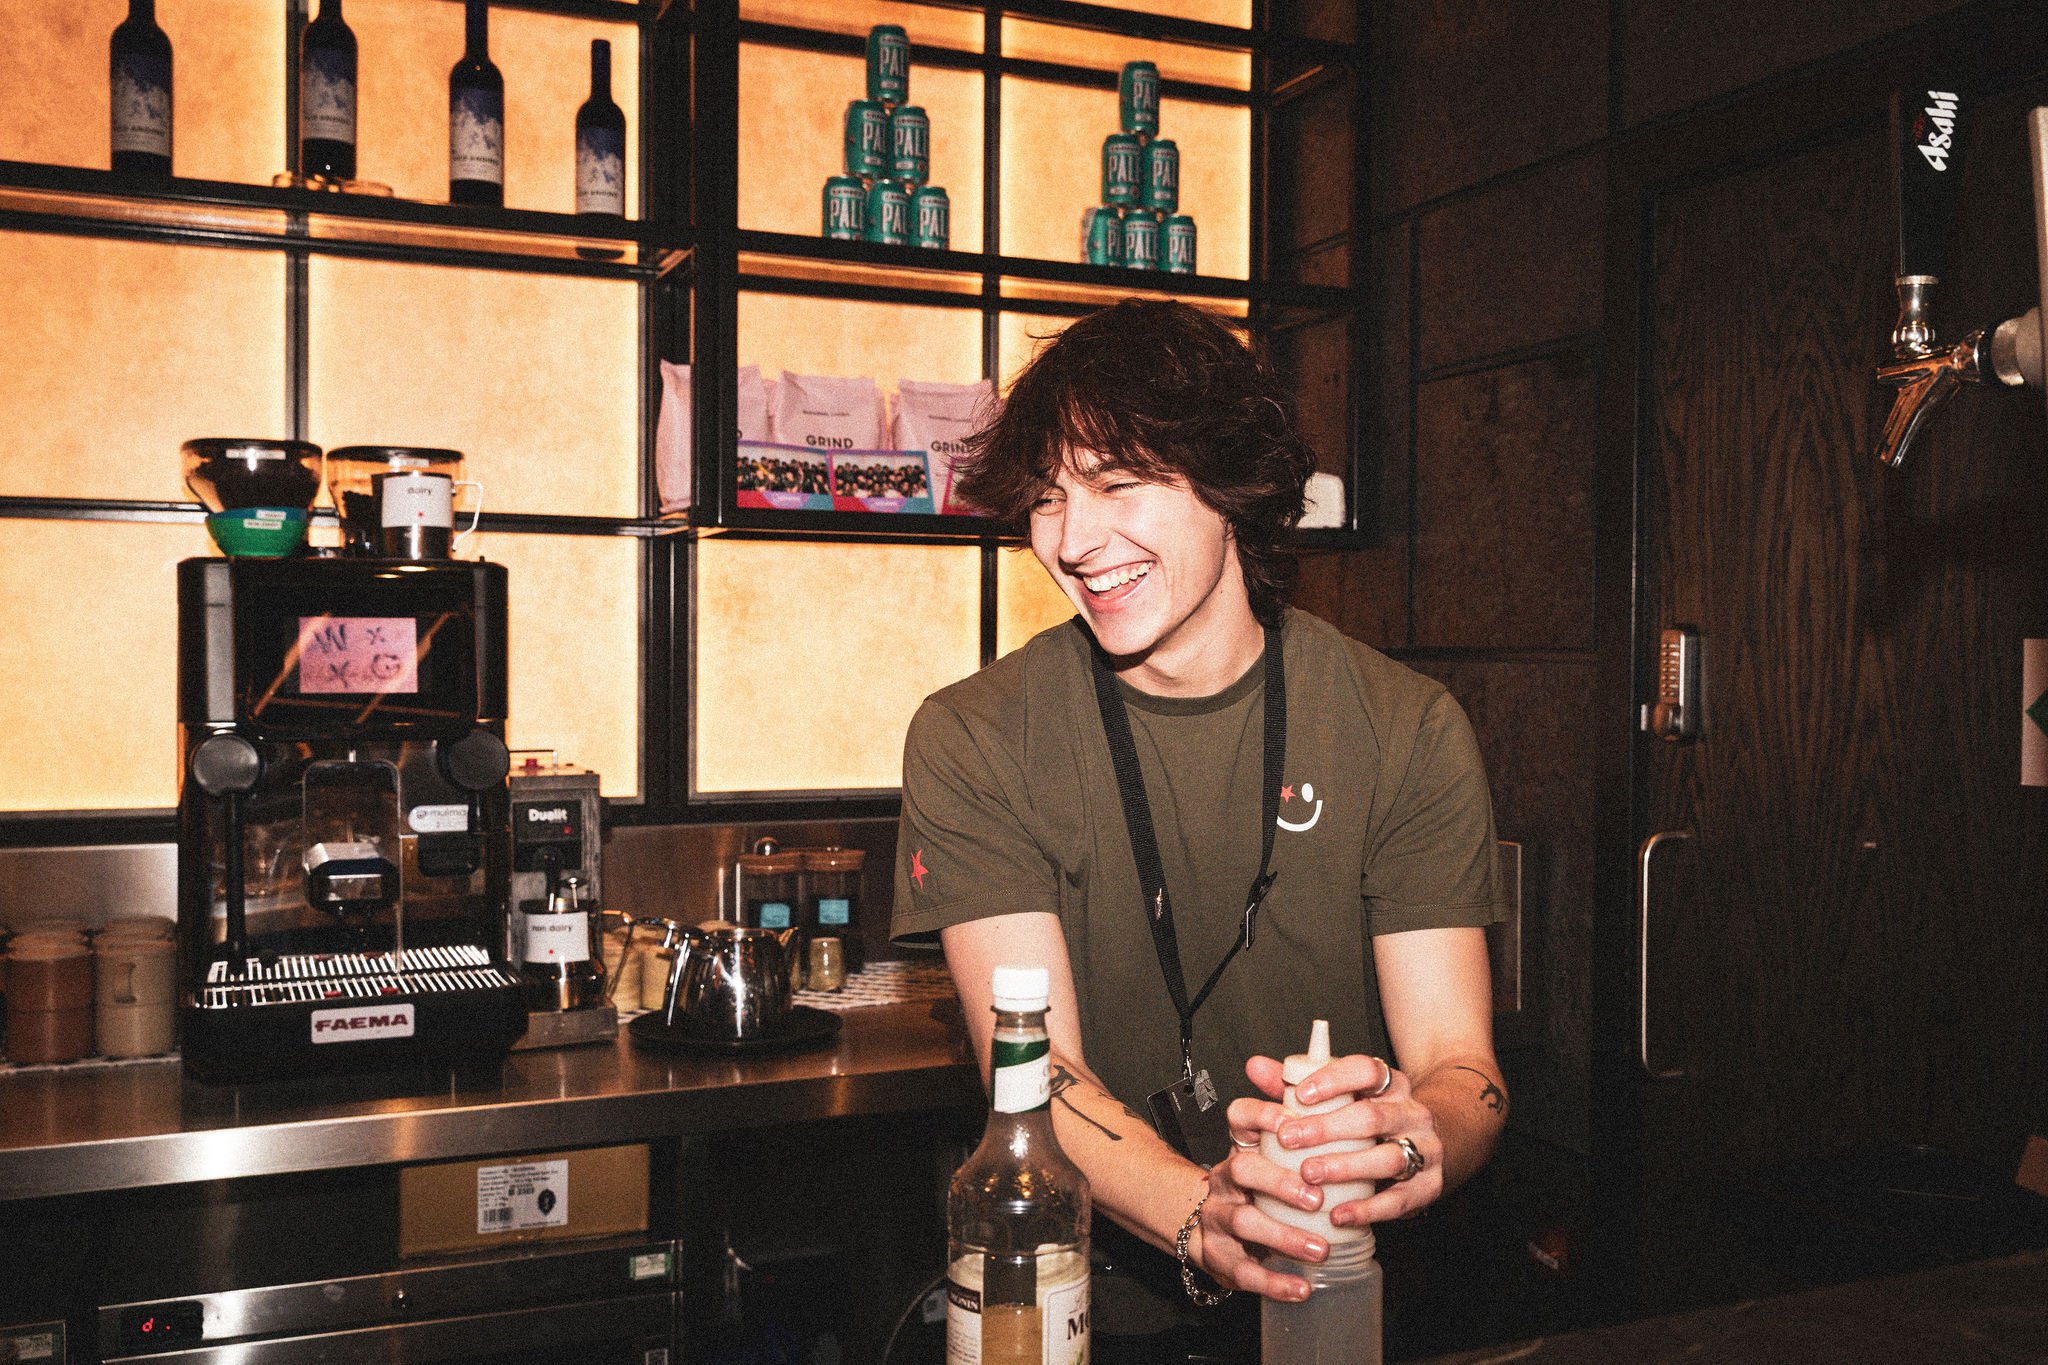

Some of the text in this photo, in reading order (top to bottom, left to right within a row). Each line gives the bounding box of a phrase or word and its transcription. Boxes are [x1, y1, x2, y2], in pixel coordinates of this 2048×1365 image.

[1917, 90, 1960, 172] Asahi
[806, 435, 854, 450] GRIND
[407, 486, 433, 497] dairy
[528, 808, 568, 822] Dualit
[549, 923, 573, 935] dairy
[314, 1013, 409, 1033] FAEMA
